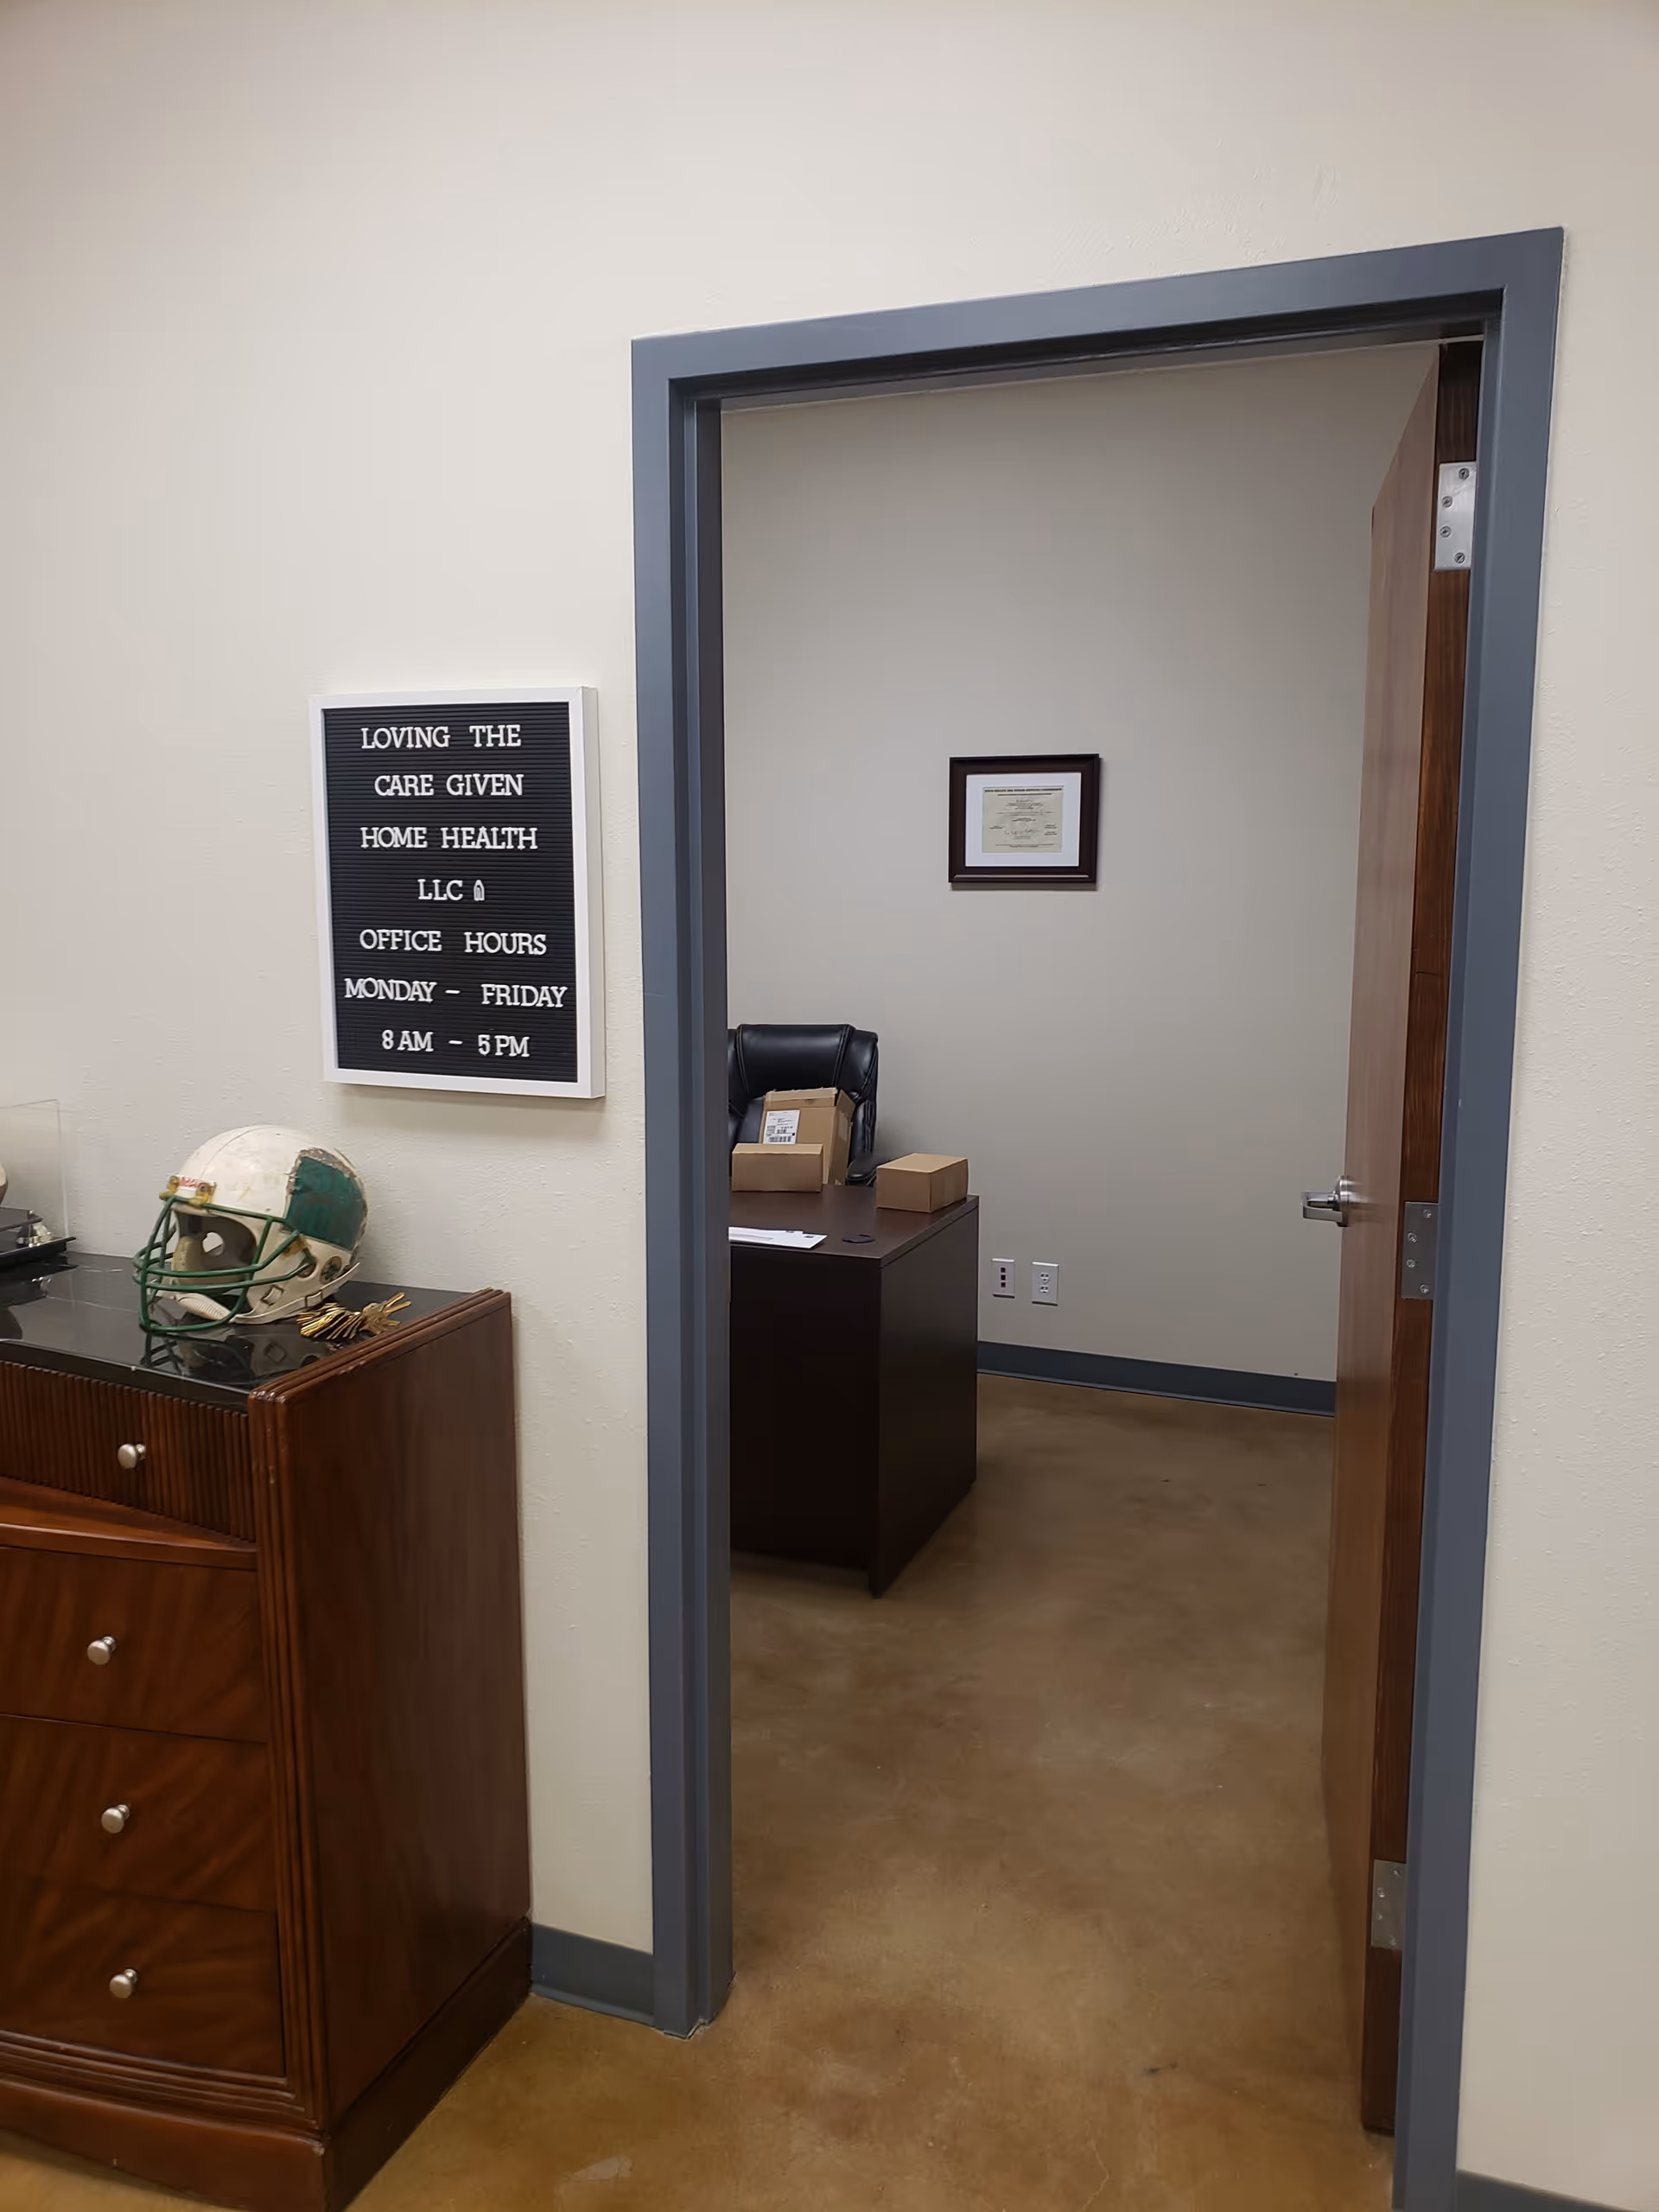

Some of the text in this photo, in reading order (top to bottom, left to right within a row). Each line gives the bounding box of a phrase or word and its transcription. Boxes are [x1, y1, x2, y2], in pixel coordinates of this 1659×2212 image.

[360, 724, 522, 749] LOVING THE
[374, 772, 524, 797] CARE GIVEN
[359, 825, 538, 850] HOME HEALTH
[416, 878, 464, 901] LLC
[359, 928, 547, 956] OFFICE HOURS
[344, 976, 438, 1003] MONDAY
[480, 983, 569, 1008] FRIDAY
